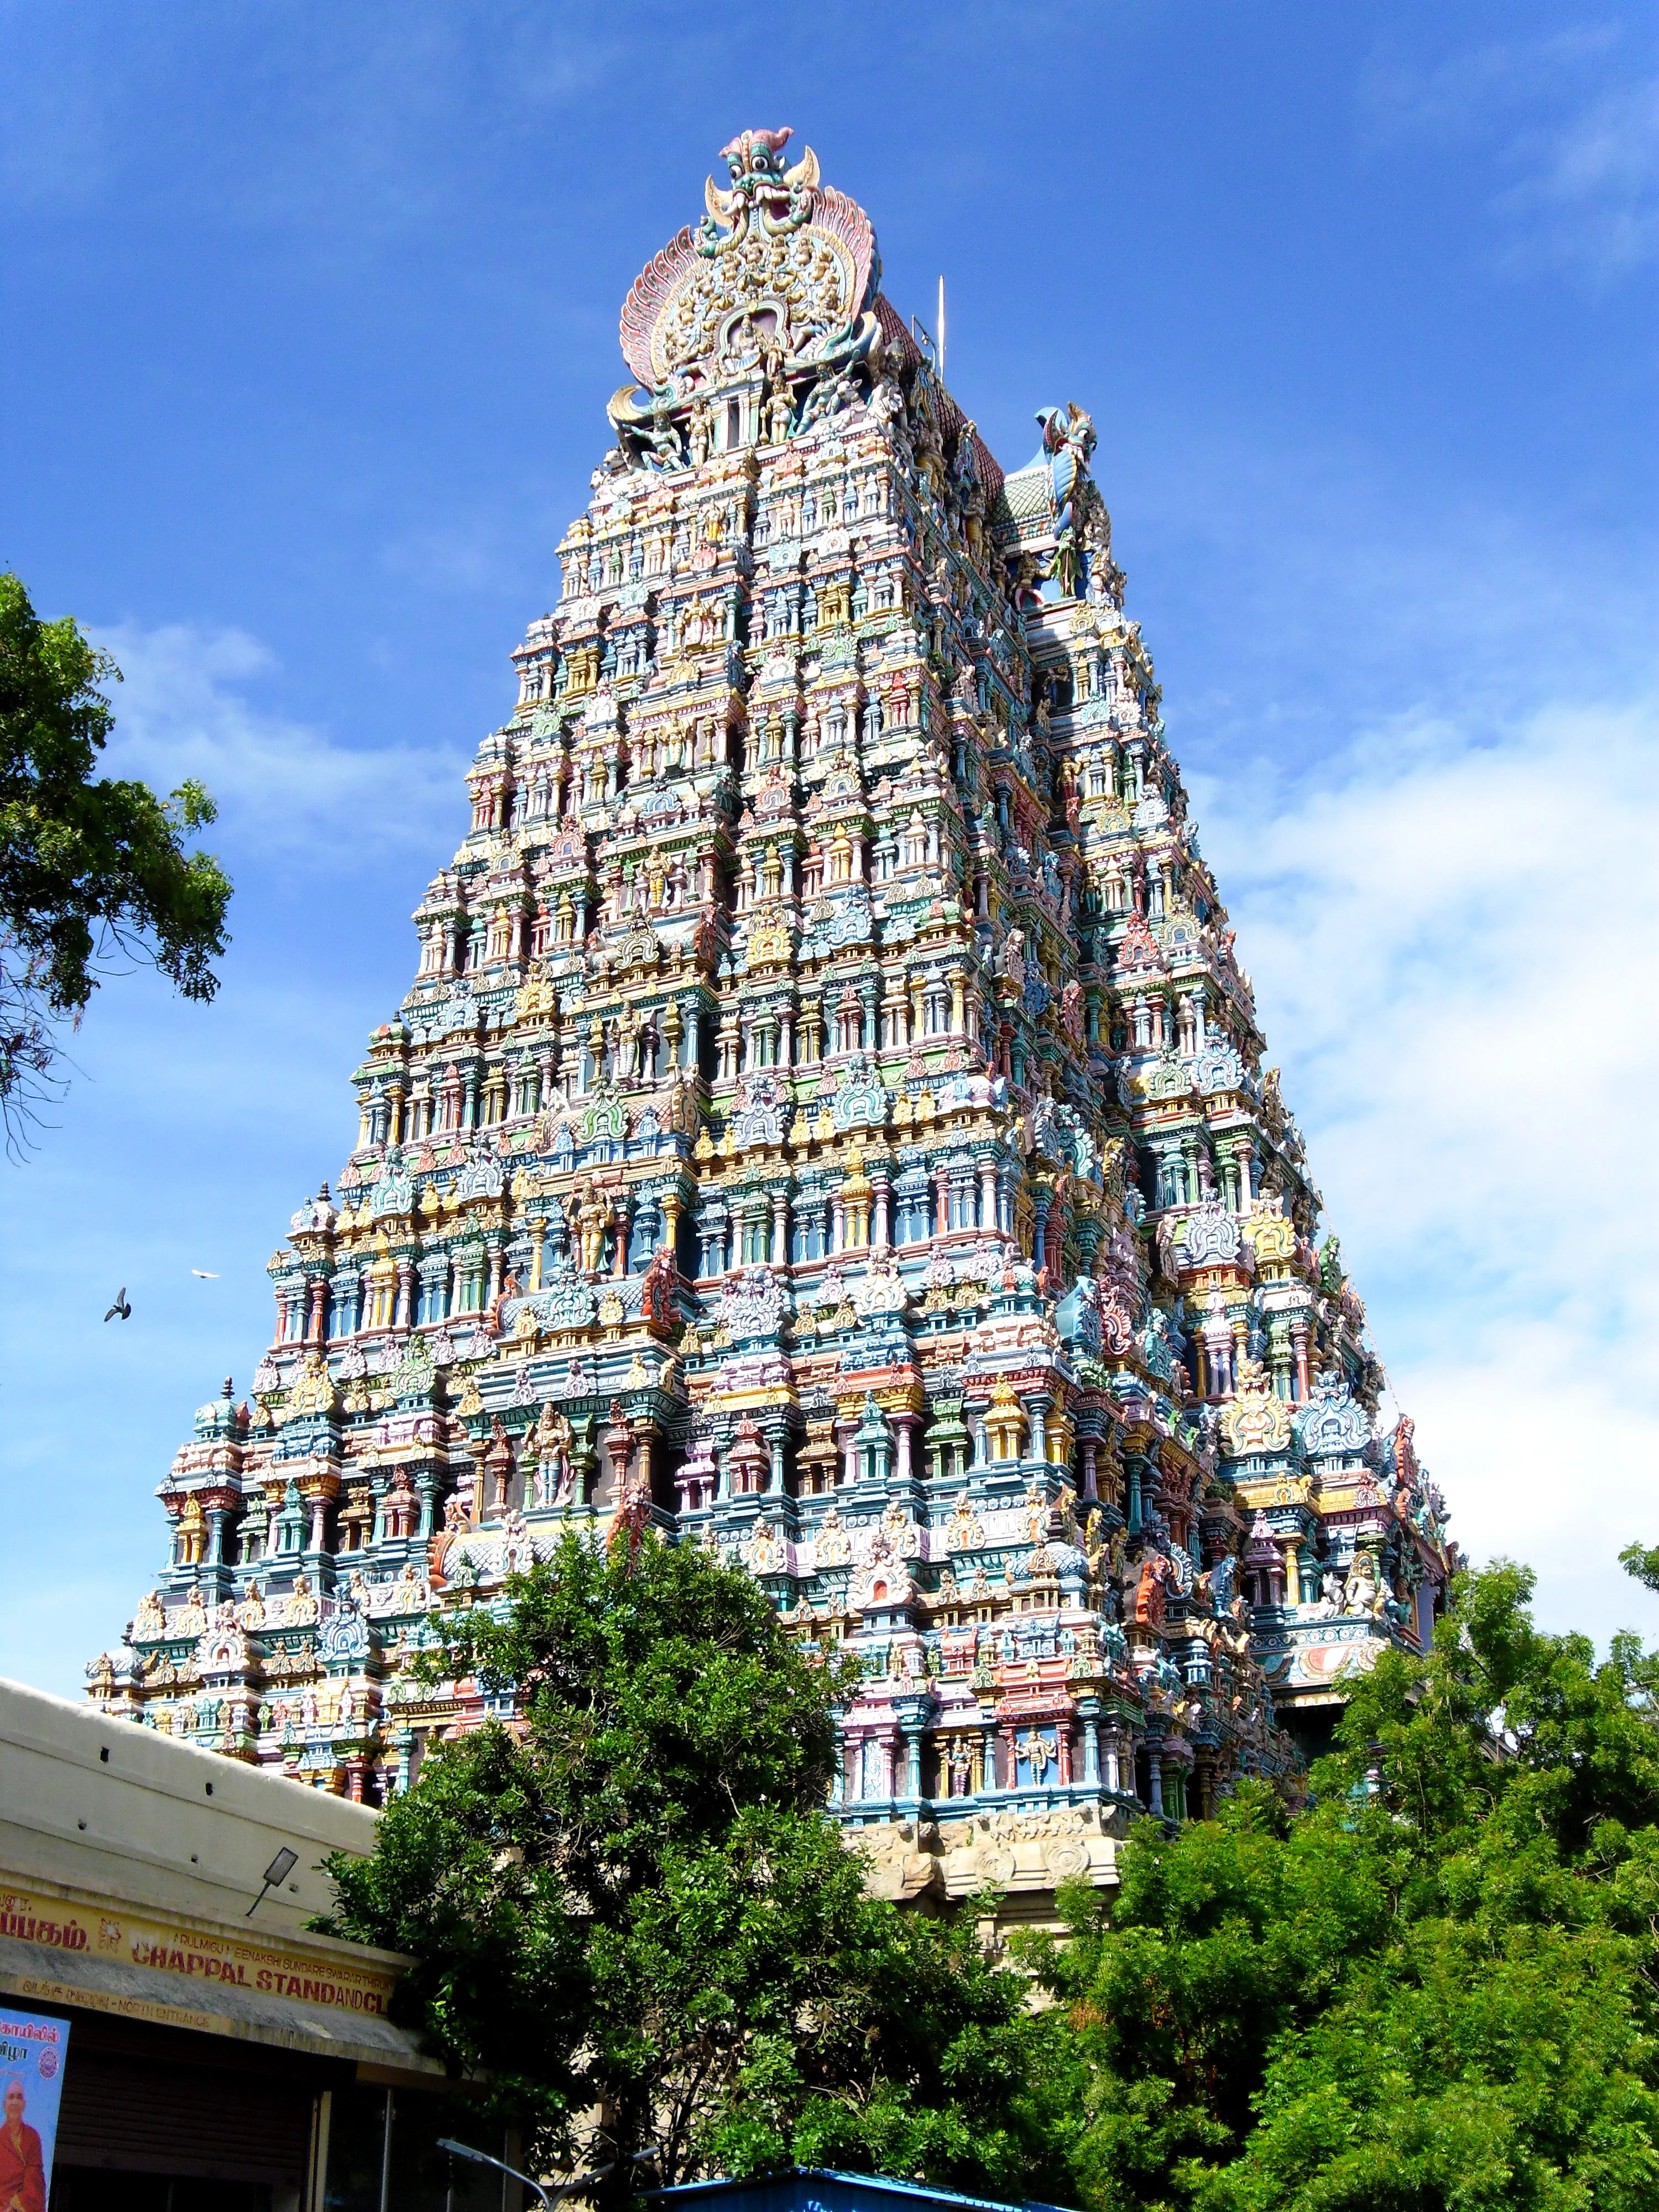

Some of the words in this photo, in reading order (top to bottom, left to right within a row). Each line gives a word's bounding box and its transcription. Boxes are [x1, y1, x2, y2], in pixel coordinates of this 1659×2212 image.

[132, 1942, 252, 1987] CHAPPAL
[256, 1969, 335, 2004] STAND
[363, 1992, 388, 2015] CL
[362, 1975, 390, 1992] THIRUK
